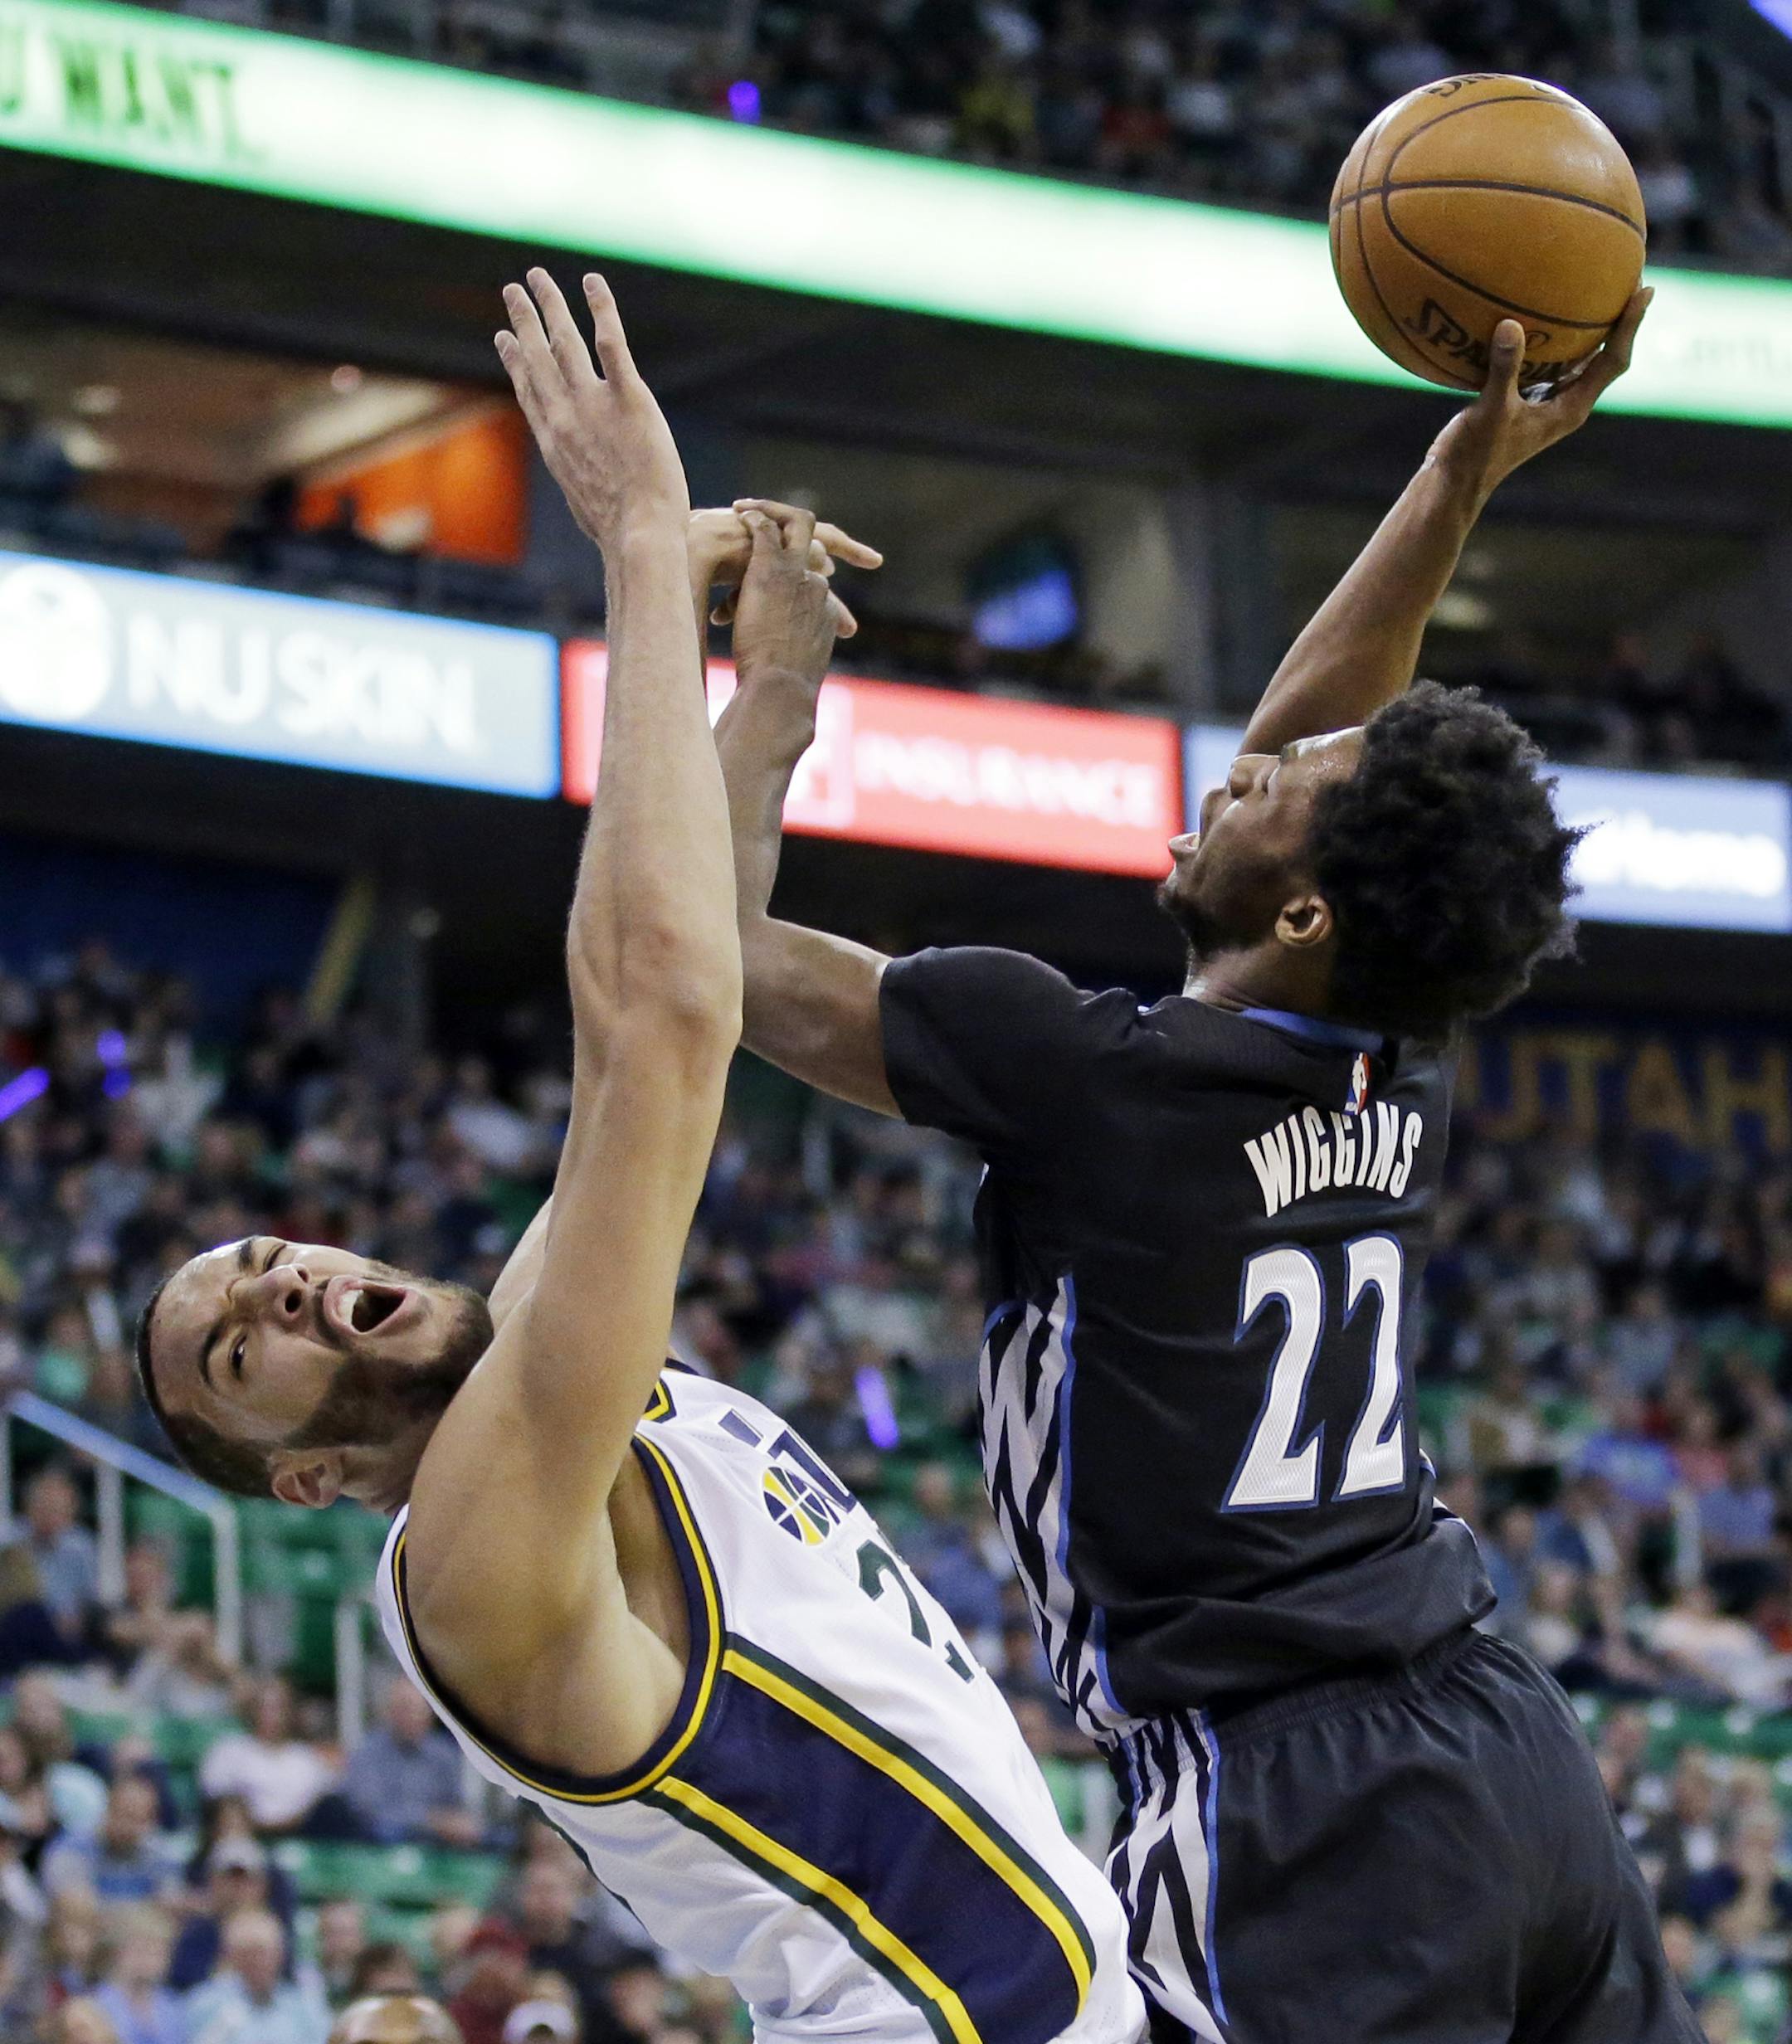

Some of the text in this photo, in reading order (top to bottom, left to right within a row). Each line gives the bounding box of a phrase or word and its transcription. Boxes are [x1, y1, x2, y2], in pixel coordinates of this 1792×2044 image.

[126, 610, 271, 725] NU
[1456, 1030, 1788, 1155] UTAH
[1244, 1101, 1423, 1218] WIGGINS
[1220, 1230, 1406, 1513] 22
